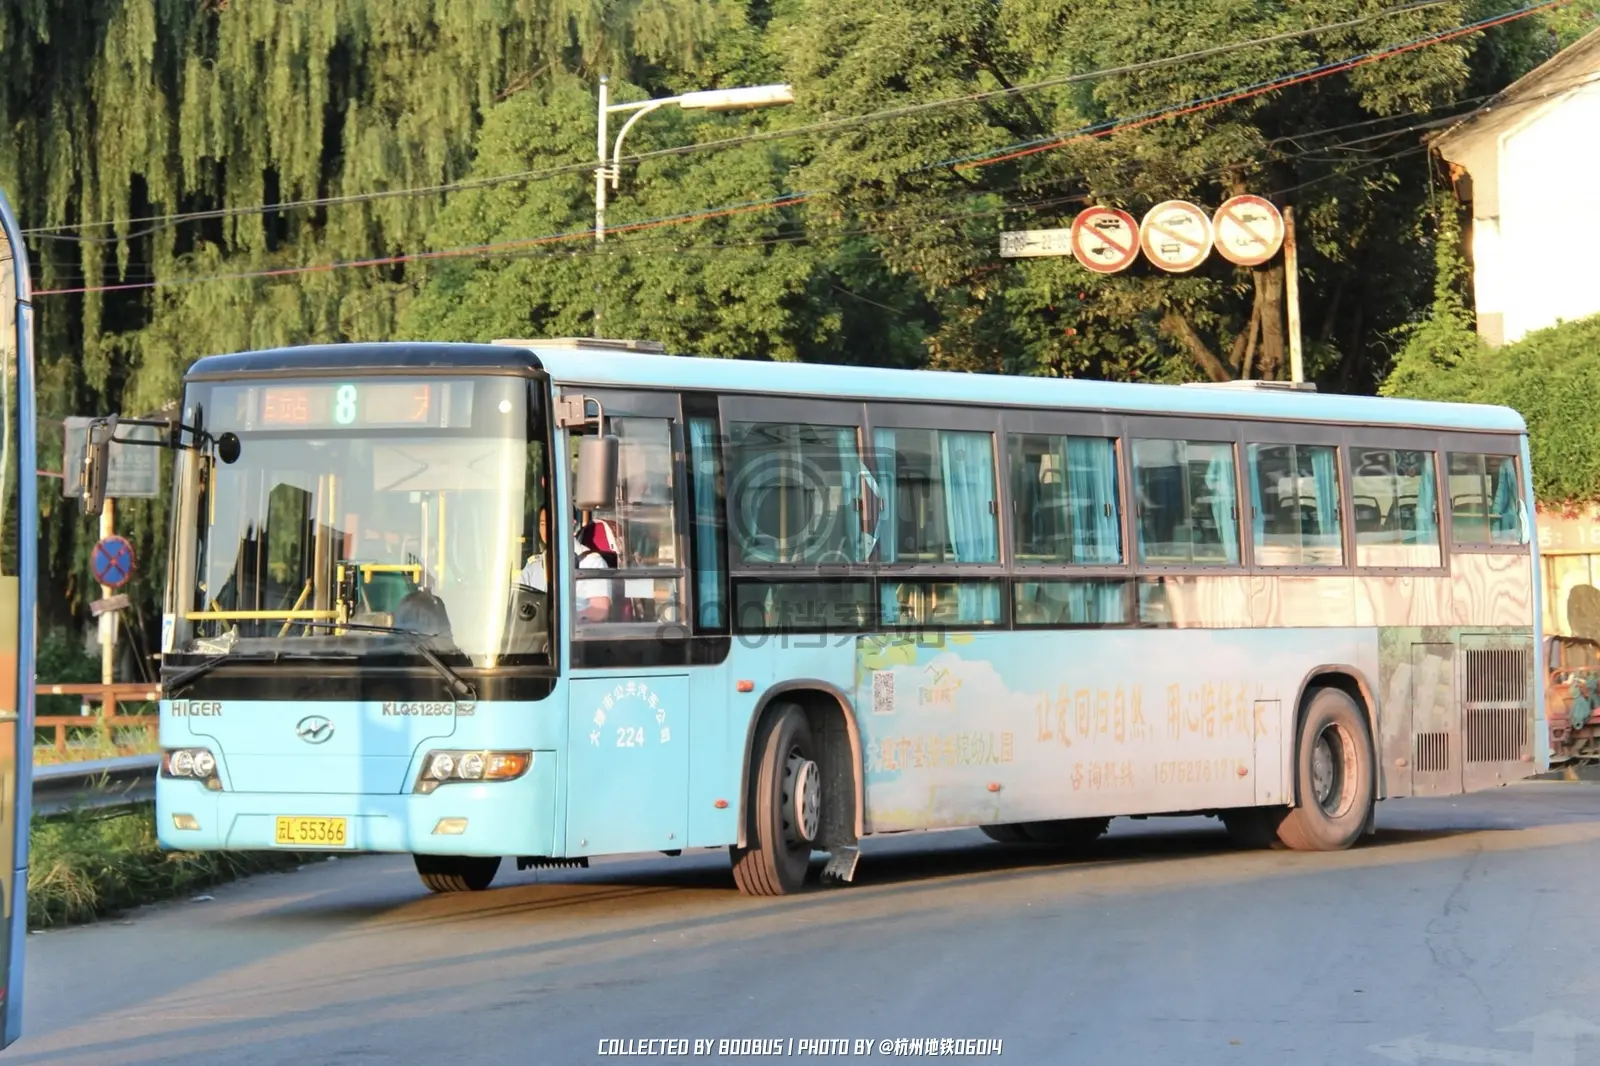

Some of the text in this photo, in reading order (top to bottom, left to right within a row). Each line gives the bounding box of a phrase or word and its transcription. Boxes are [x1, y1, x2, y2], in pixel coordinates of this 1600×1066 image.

[335, 384, 357, 424] 8
[171, 701, 222, 716] HIGER
[616, 726, 645, 748] 224
